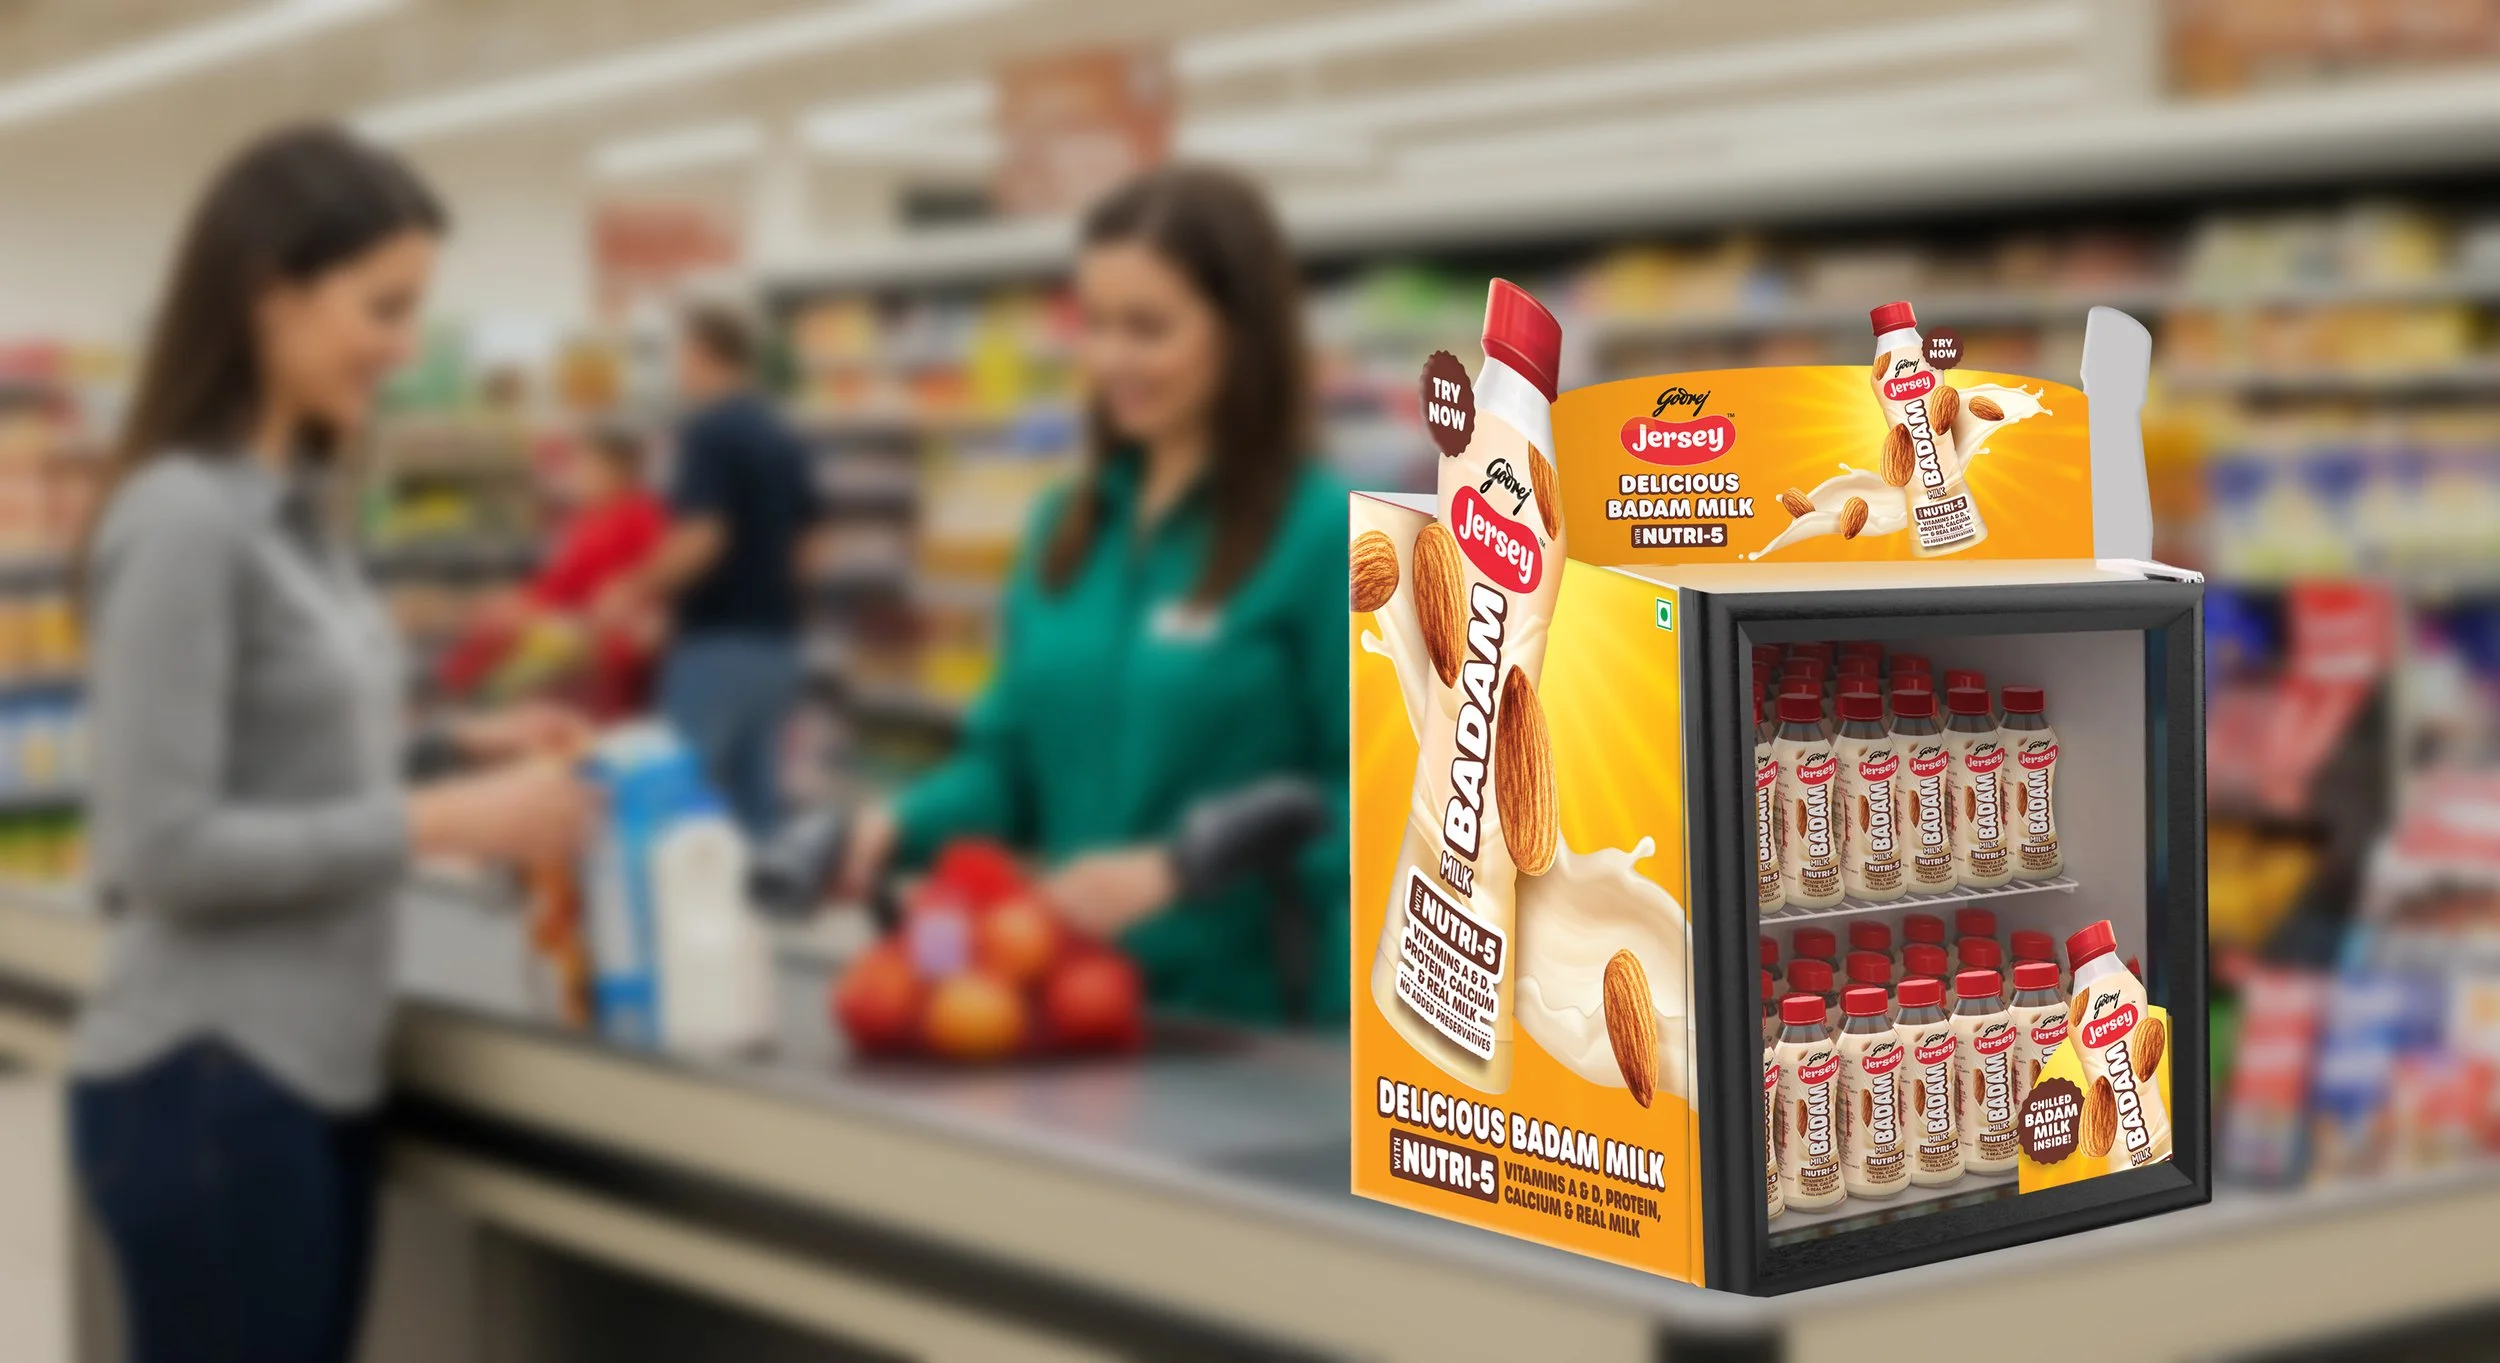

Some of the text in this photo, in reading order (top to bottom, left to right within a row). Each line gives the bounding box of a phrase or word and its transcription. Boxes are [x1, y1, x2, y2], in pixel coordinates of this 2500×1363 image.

[1932, 339, 1953, 347] TRY
[1929, 349, 1956, 359] NOW
[1895, 359, 1919, 378] Godrej
[1433, 377, 1461, 404] TRY
[1890, 376, 1930, 397] Jersey
[1652, 387, 1711, 417] Godrej
[1428, 401, 1466, 432] NOW
[1632, 424, 1724, 452] Jersey
[1905, 399, 1944, 488] BADAM
[1480, 457, 1532, 516] Godrej
[1619, 473, 1739, 495] DELICIOUS
[1927, 487, 1947, 500] MILK
[1606, 497, 1754, 520] BADAM MILK
[1923, 499, 1964, 517] NUTRI-5
[1922, 516, 1949, 526] VITAMINS
[1946, 516, 1970, 527] CALCIUM
[1459, 498, 1534, 585] Jersey
[1642, 527, 1724, 544] NUTRI-5
[1444, 582, 1508, 862] BADAM
[1911, 756, 1947, 771] Jersey
[1967, 752, 2003, 767] Jersey
[2020, 749, 2056, 764] Jersey
[1758, 765, 1777, 781] sey
[1798, 763, 1835, 779] Jersey
[1861, 761, 1897, 775] Jersey
[1920, 776, 1943, 845] BADAM
[1976, 772, 1998, 841] BADAM
[2028, 768, 2049, 834] BADAM
[1808, 784, 1829, 857] BADAM
[1869, 780, 1892, 851] BADAM
[1979, 841, 1998, 849] MILK
[2025, 843, 2056, 853] NUTRI-5
[2029, 834, 2049, 844] MILK
[1873, 851, 1893, 862] MILK
[1920, 855, 1950, 865] NUTRI-5
[1923, 845, 1943, 855] MILK
[1975, 849, 2005, 859] NUTRI-5
[1807, 867, 1837, 878] NUTRI-5
[1810, 857, 1830, 868] MILK
[1869, 861, 1900, 871] NUTRI-5
[1440, 850, 1474, 898] MILK
[1414, 884, 1496, 965] WITH NUTRI-5
[1414, 924, 1490, 993] VITAMINS A & D,
[1405, 936, 1494, 1013] PROTEIN, CALCIUM
[1417, 969, 1477, 1023] & REAL MILK
[2094, 990, 2120, 1019] Godrej
[1400, 977, 1491, 1053] NO ADDED PRESERVATIVES
[2033, 1024, 2067, 1040] Jerse
[2088, 1010, 2133, 1044] Jersey
[1917, 1040, 1955, 1060] Jersey
[1976, 1034, 2015, 1050] Jersey
[1800, 1059, 1838, 1079] Jersey
[1864, 1050, 1902, 1070] Jersey
[1985, 1052, 2009, 1123] BADAM
[2105, 1040, 2149, 1152] BADAM
[1872, 1072, 1896, 1144] BADAM
[1925, 1062, 1949, 1134] BADAM
[2030, 1094, 2071, 1111] CHILLED
[1808, 1082, 1830, 1156] BADAM
[2024, 1103, 2078, 1127] BADAM
[1378, 1077, 1665, 1192] DELICIOUS BADAM MILK
[1984, 1130, 2017, 1142] NUTRI-5
[1988, 1121, 2010, 1132] MILK
[2033, 1120, 2071, 1140] MILK
[1924, 1140, 1957, 1153] NUTRI-5
[1928, 1132, 1950, 1144] MILK
[2033, 1133, 2071, 1151] INSIDE!
[1871, 1152, 1903, 1165] NUTRI-5
[1875, 1143, 1896, 1154] MILK
[2131, 1147, 2152, 1166] MILK
[1393, 1137, 1495, 1195] WITH NUTRI-5
[1806, 1163, 1837, 1177] NUTRI-5
[1809, 1155, 1830, 1166] MILK
[1504, 1161, 1661, 1223] VITAMINS A & D, PROTEIN,
[1504, 1185, 1640, 1238] CALCIUM & REAL MILK
